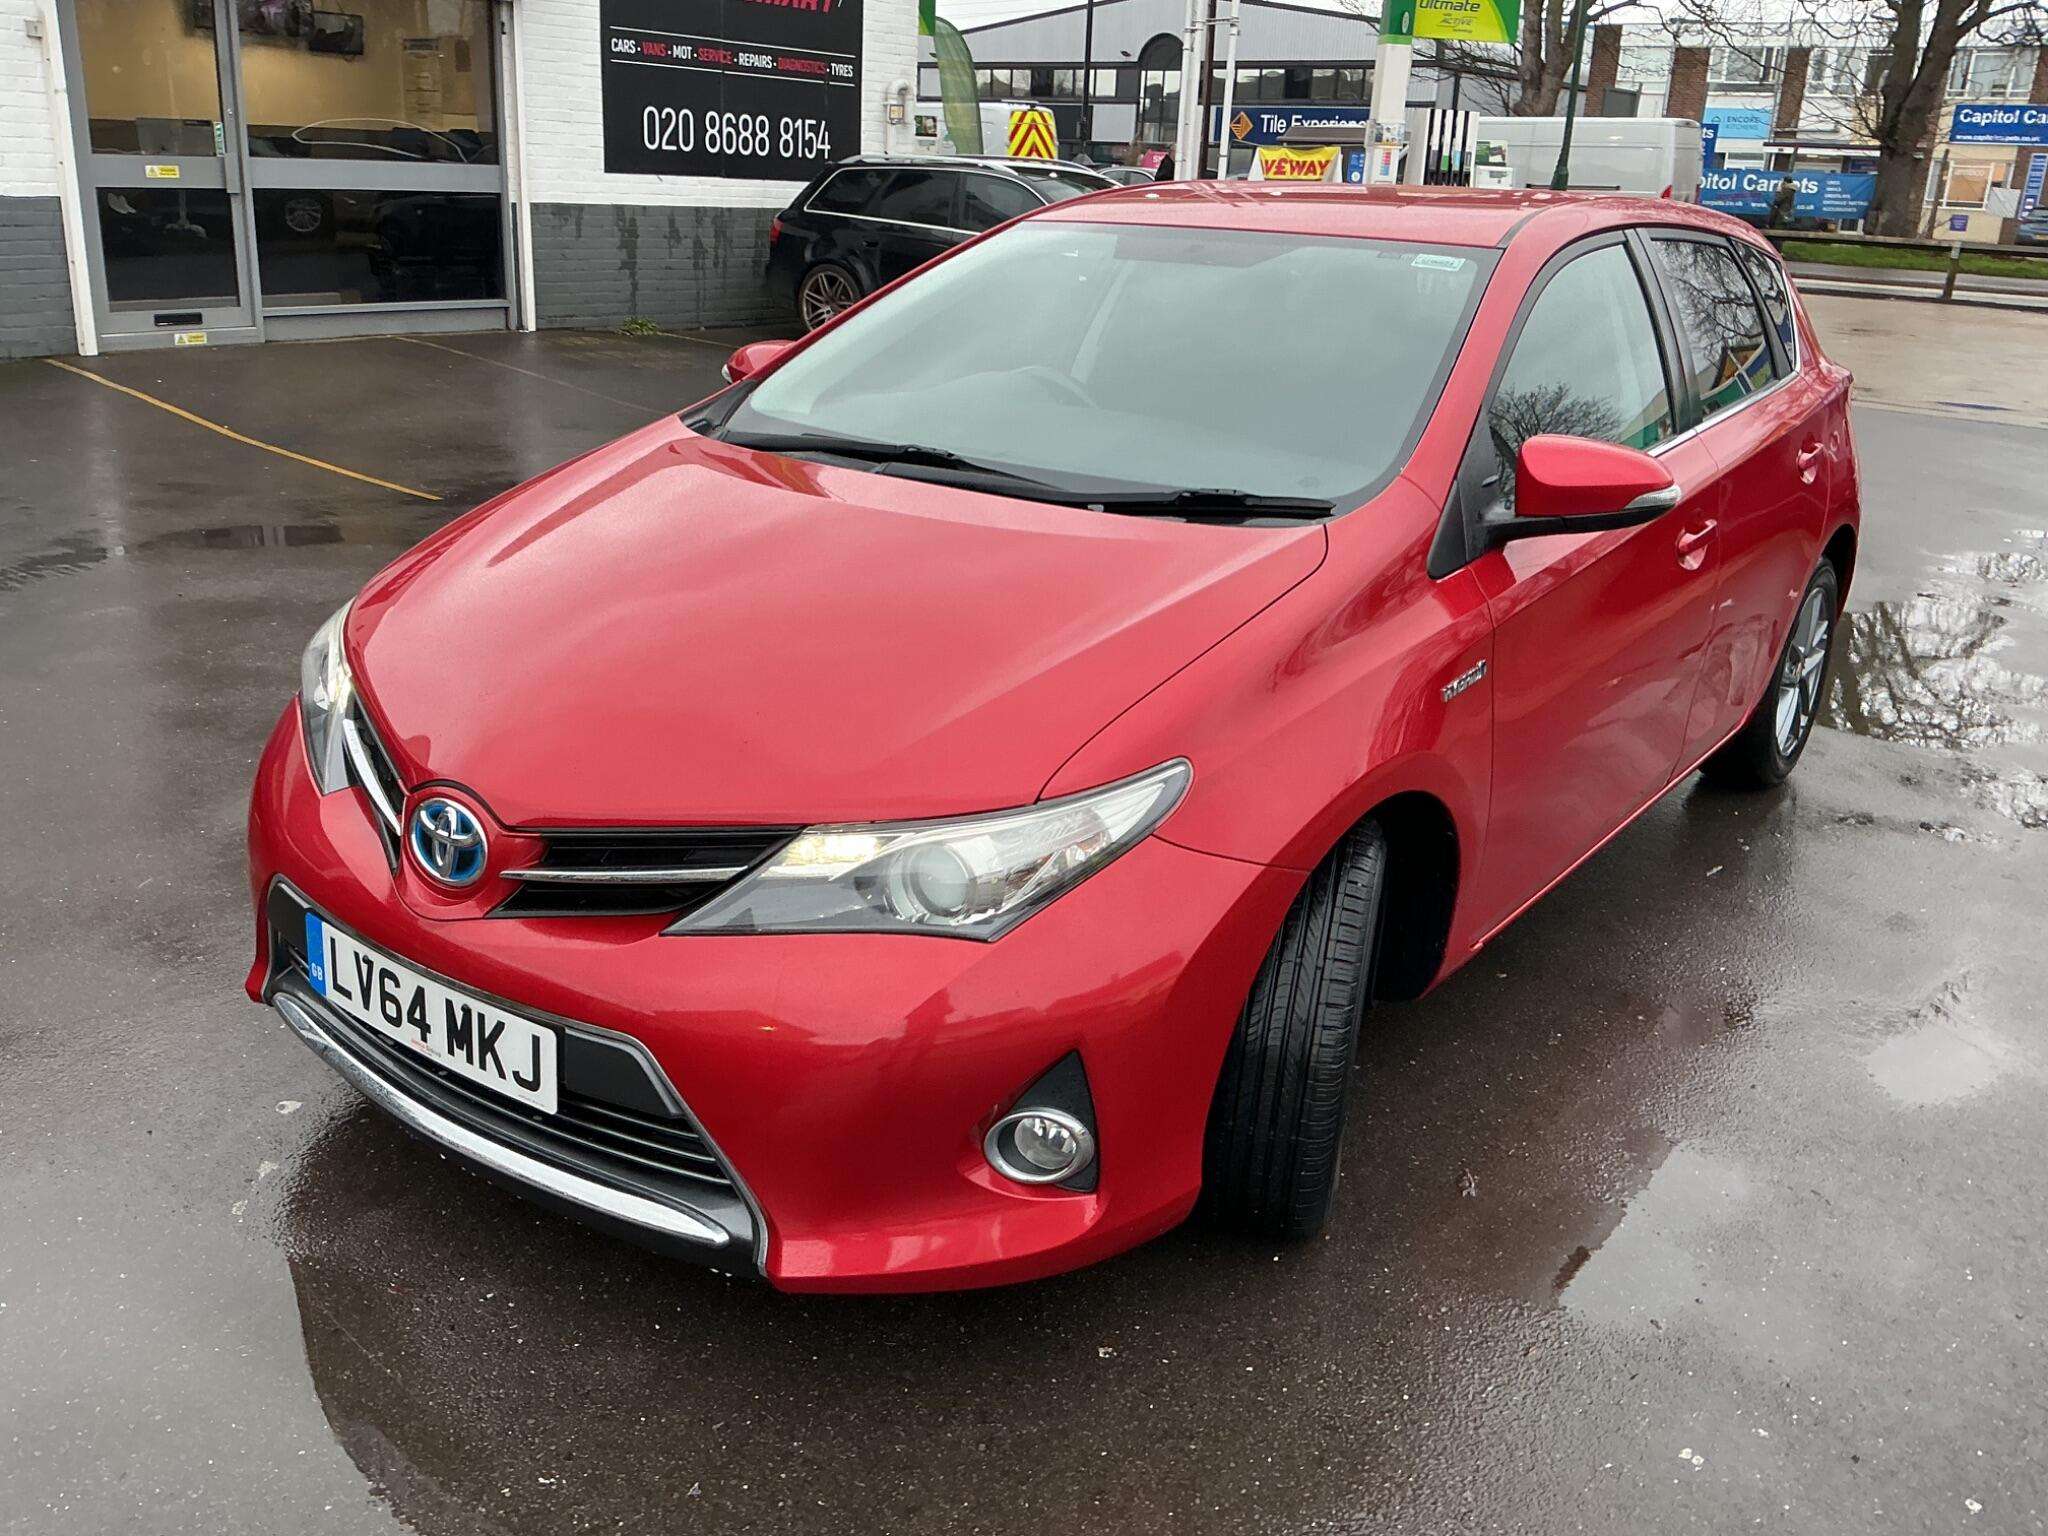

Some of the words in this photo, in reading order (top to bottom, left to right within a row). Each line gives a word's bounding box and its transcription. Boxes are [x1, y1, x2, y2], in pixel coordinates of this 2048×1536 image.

[611, 38, 636, 54] CARS
[642, 41, 667, 57] VANS
[672, 45, 692, 59] MOT
[698, 48, 732, 64] SERVICE
[738, 53, 773, 68] REPAIRS
[778, 58, 826, 74] DIAGNOSTICS
[831, 62, 854, 77] TYRES
[1260, 114, 1286, 134] Tile
[1960, 108, 2020, 126] Capitol
[2023, 109, 2048, 124] Ca
[642, 106, 695, 152] 020
[705, 110, 769, 157] 8688
[779, 117, 831, 160] 8154
[311, 962, 323, 981] GB
[330, 937, 431, 1043] LV64
[445, 997, 541, 1092] MKJ
